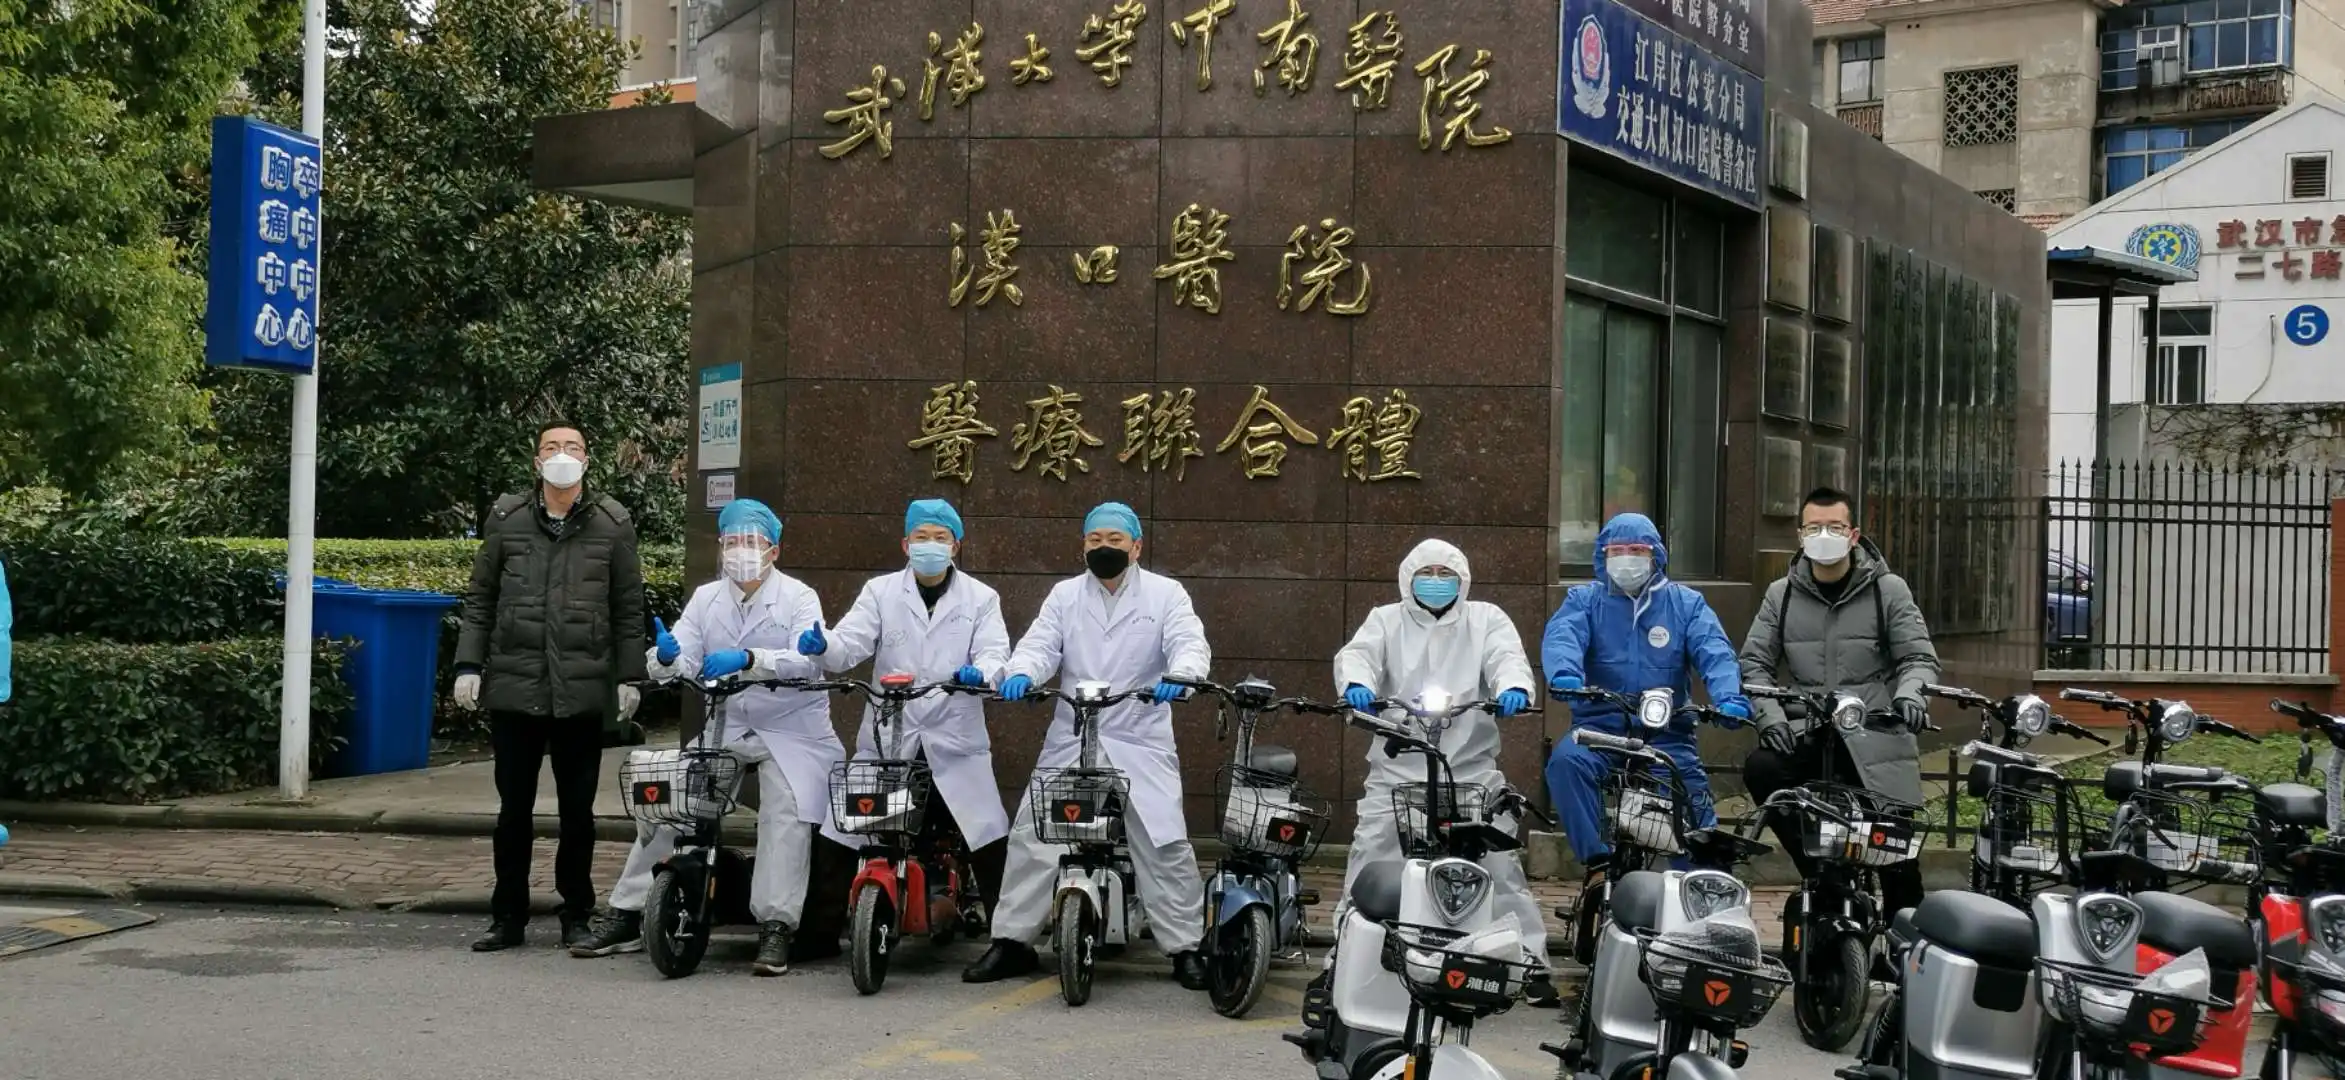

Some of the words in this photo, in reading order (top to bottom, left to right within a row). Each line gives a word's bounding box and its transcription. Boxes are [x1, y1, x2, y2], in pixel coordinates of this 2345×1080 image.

[1655, 0, 1750, 53] 医院警务室
[1634, 31, 1746, 131] 江岸区公安分局
[1615, 84, 1757, 194] 交通大队汉口医院警务区
[254, 145, 292, 347] 胸痛中心
[286, 156, 319, 351] 卒中中心
[948, 203, 1373, 315] 漢口醫院
[2234, 250, 2343, 283] 二七路
[2296, 311, 2318, 340] 5
[907, 379, 1424, 483] 醫療聯合體
